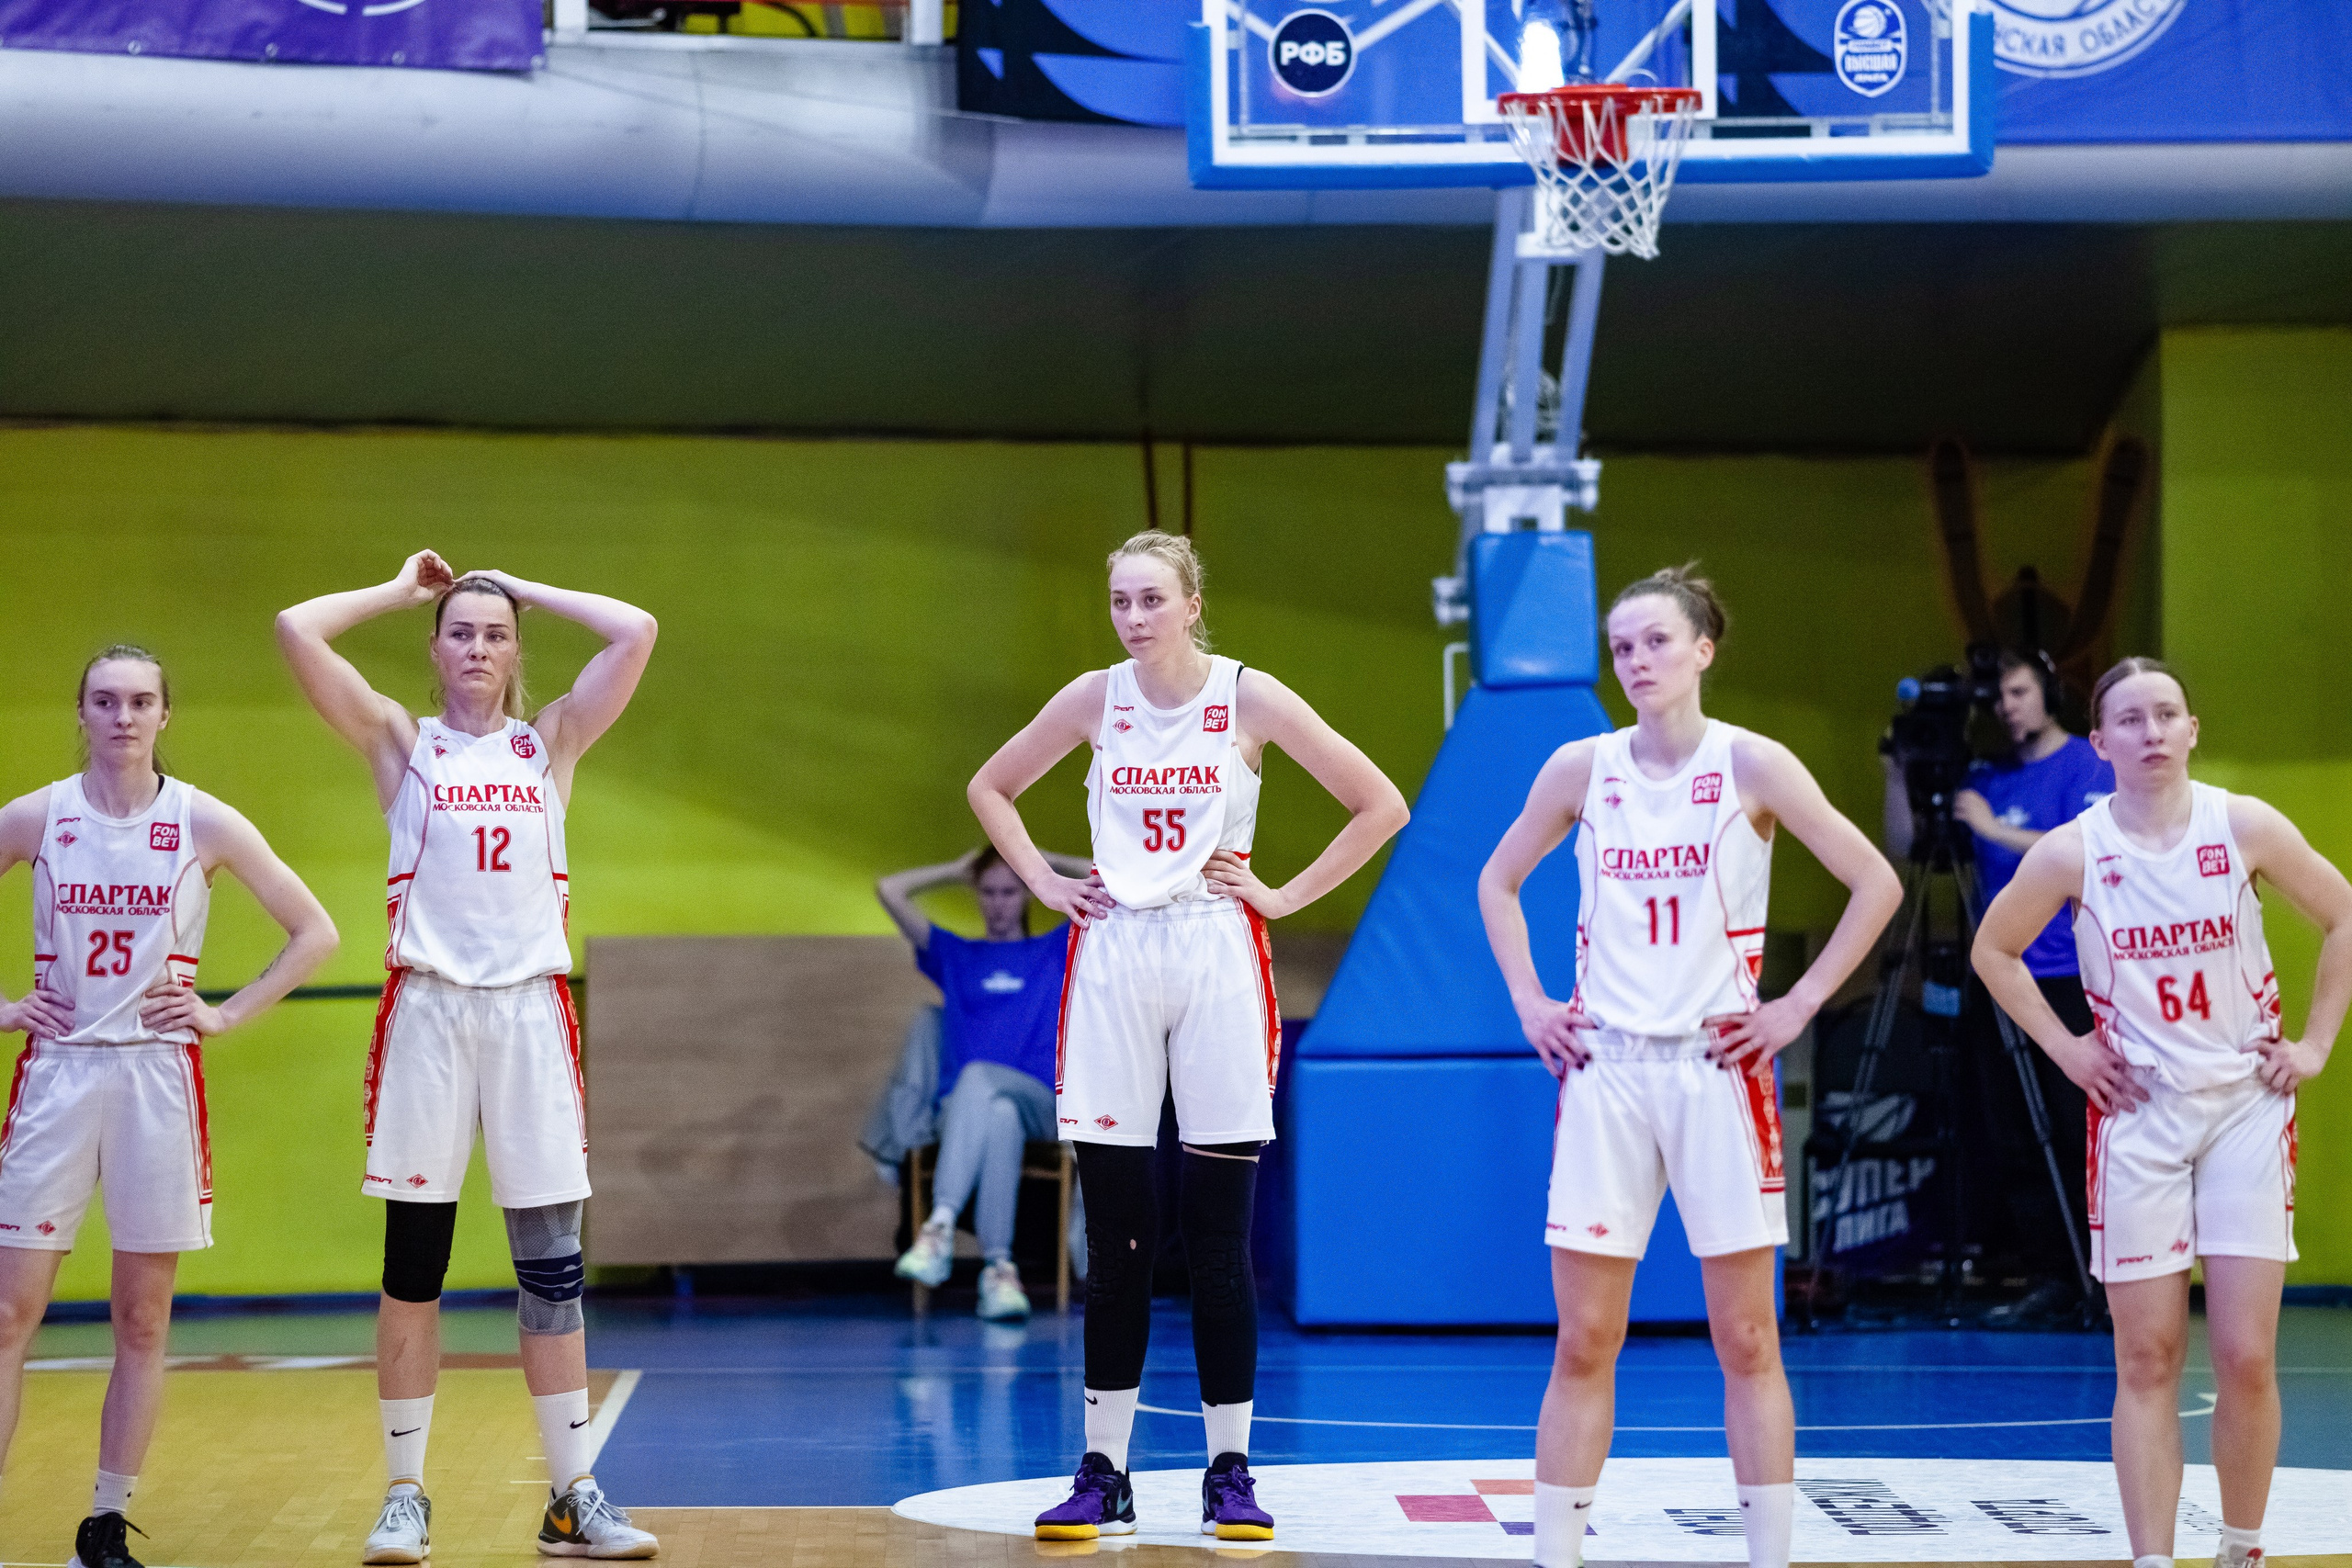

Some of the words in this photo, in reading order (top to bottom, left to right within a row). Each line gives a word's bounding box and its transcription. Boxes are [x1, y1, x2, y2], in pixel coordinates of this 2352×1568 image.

[2079, 0, 2156, 53] ОБЛАС
[1280, 39, 1347, 66] РФБ
[1204, 717, 1227, 728] BET
[1205, 707, 1227, 718] FON
[1112, 765, 1220, 786] СПАРТАК
[435, 784, 541, 805] СПАРТАК
[1110, 785, 1176, 795] МОСКОВСКАЯ
[1180, 785, 1222, 795] ОБЛАСТЬ
[432, 803, 501, 812] МОСКОВСКАЯ
[504, 804, 544, 813] ОБЛАСТЬ
[152, 835, 178, 848] BET
[153, 825, 178, 837] FON
[1142, 808, 1186, 853] 55
[471, 825, 512, 873] 12
[2199, 847, 2224, 862] FON
[58, 883, 172, 906] СПАРТАК
[1644, 895, 1679, 946] 11
[2111, 913, 2233, 950] СПАРТАК
[85, 930, 135, 977] 25
[2155, 969, 2211, 1023] 64
[1970, 1498, 2112, 1536] СПОРТА
